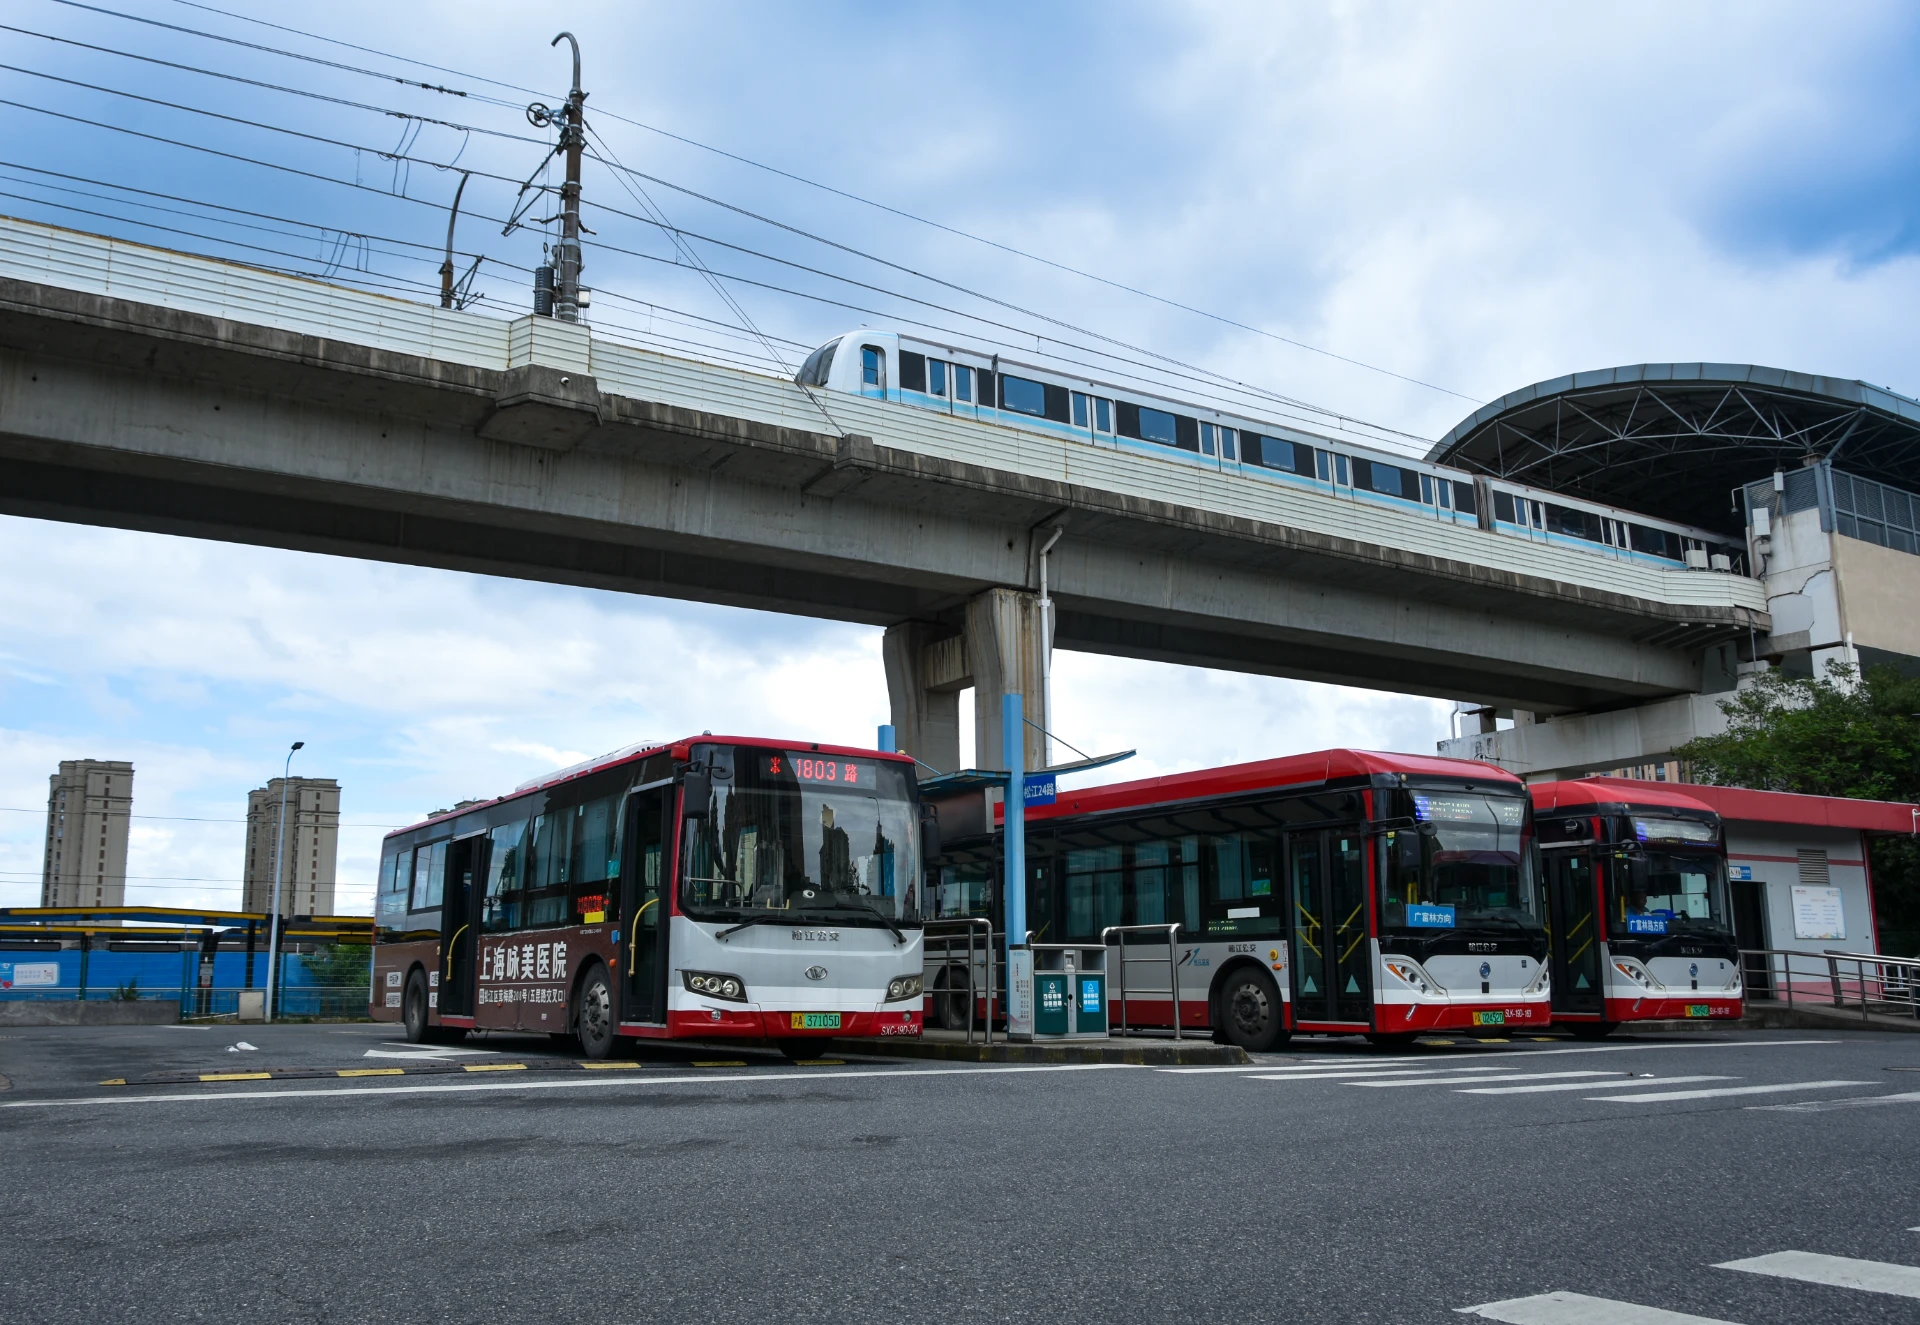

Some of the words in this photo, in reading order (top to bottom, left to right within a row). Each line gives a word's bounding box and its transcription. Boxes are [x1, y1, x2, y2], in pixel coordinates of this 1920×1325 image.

[796, 758, 836, 781] 1803
[844, 763, 858, 783] 路
[1024, 782, 1055, 799] 松江24路
[1414, 912, 1452, 924] 广富林方向
[1630, 920, 1665, 932] 广富林路方向
[479, 941, 567, 981] 上海咏美医院
[806, 1015, 840, 1027] 37105D
